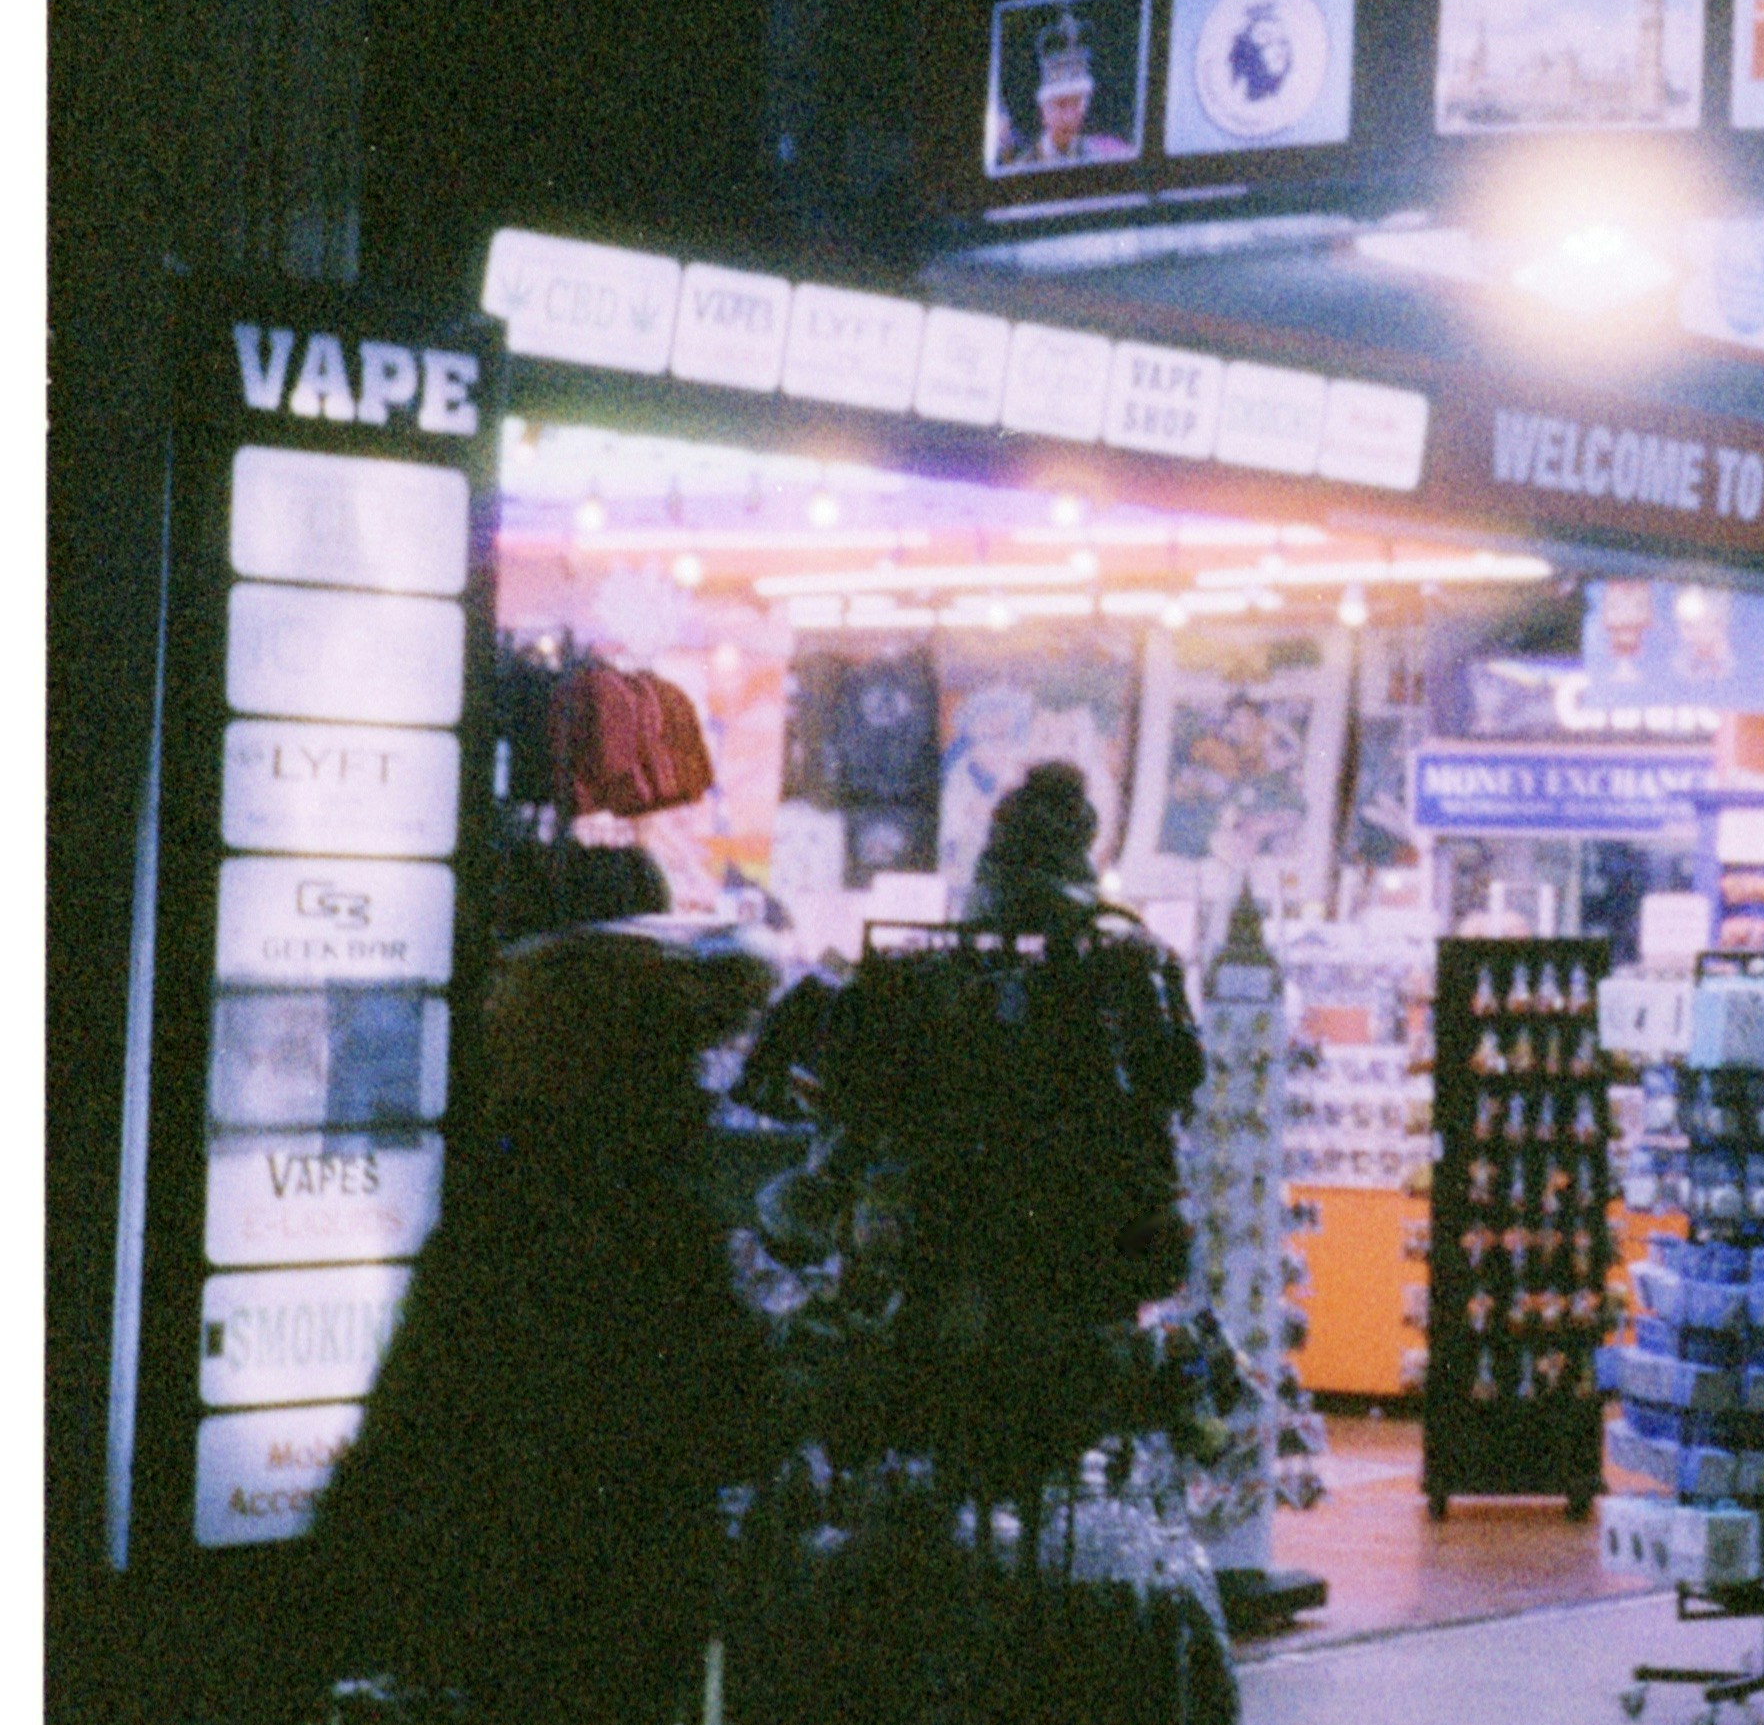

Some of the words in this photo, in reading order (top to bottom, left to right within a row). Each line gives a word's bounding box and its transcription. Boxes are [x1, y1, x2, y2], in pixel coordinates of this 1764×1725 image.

[544, 278, 621, 330] CBD
[232, 322, 481, 437] VAPE
[1131, 357, 1203, 400] VAPE
[1123, 400, 1198, 440] SHOP
[1493, 410, 1703, 512] WELCOME
[1716, 448, 1763, 522] TO
[271, 744, 402, 786] LYFT
[1424, 762, 1536, 798] MONEY
[1544, 762, 1706, 800] EXCHANG
[266, 1149, 381, 1200] VAPES
[229, 1298, 402, 1373] SMOKIN
